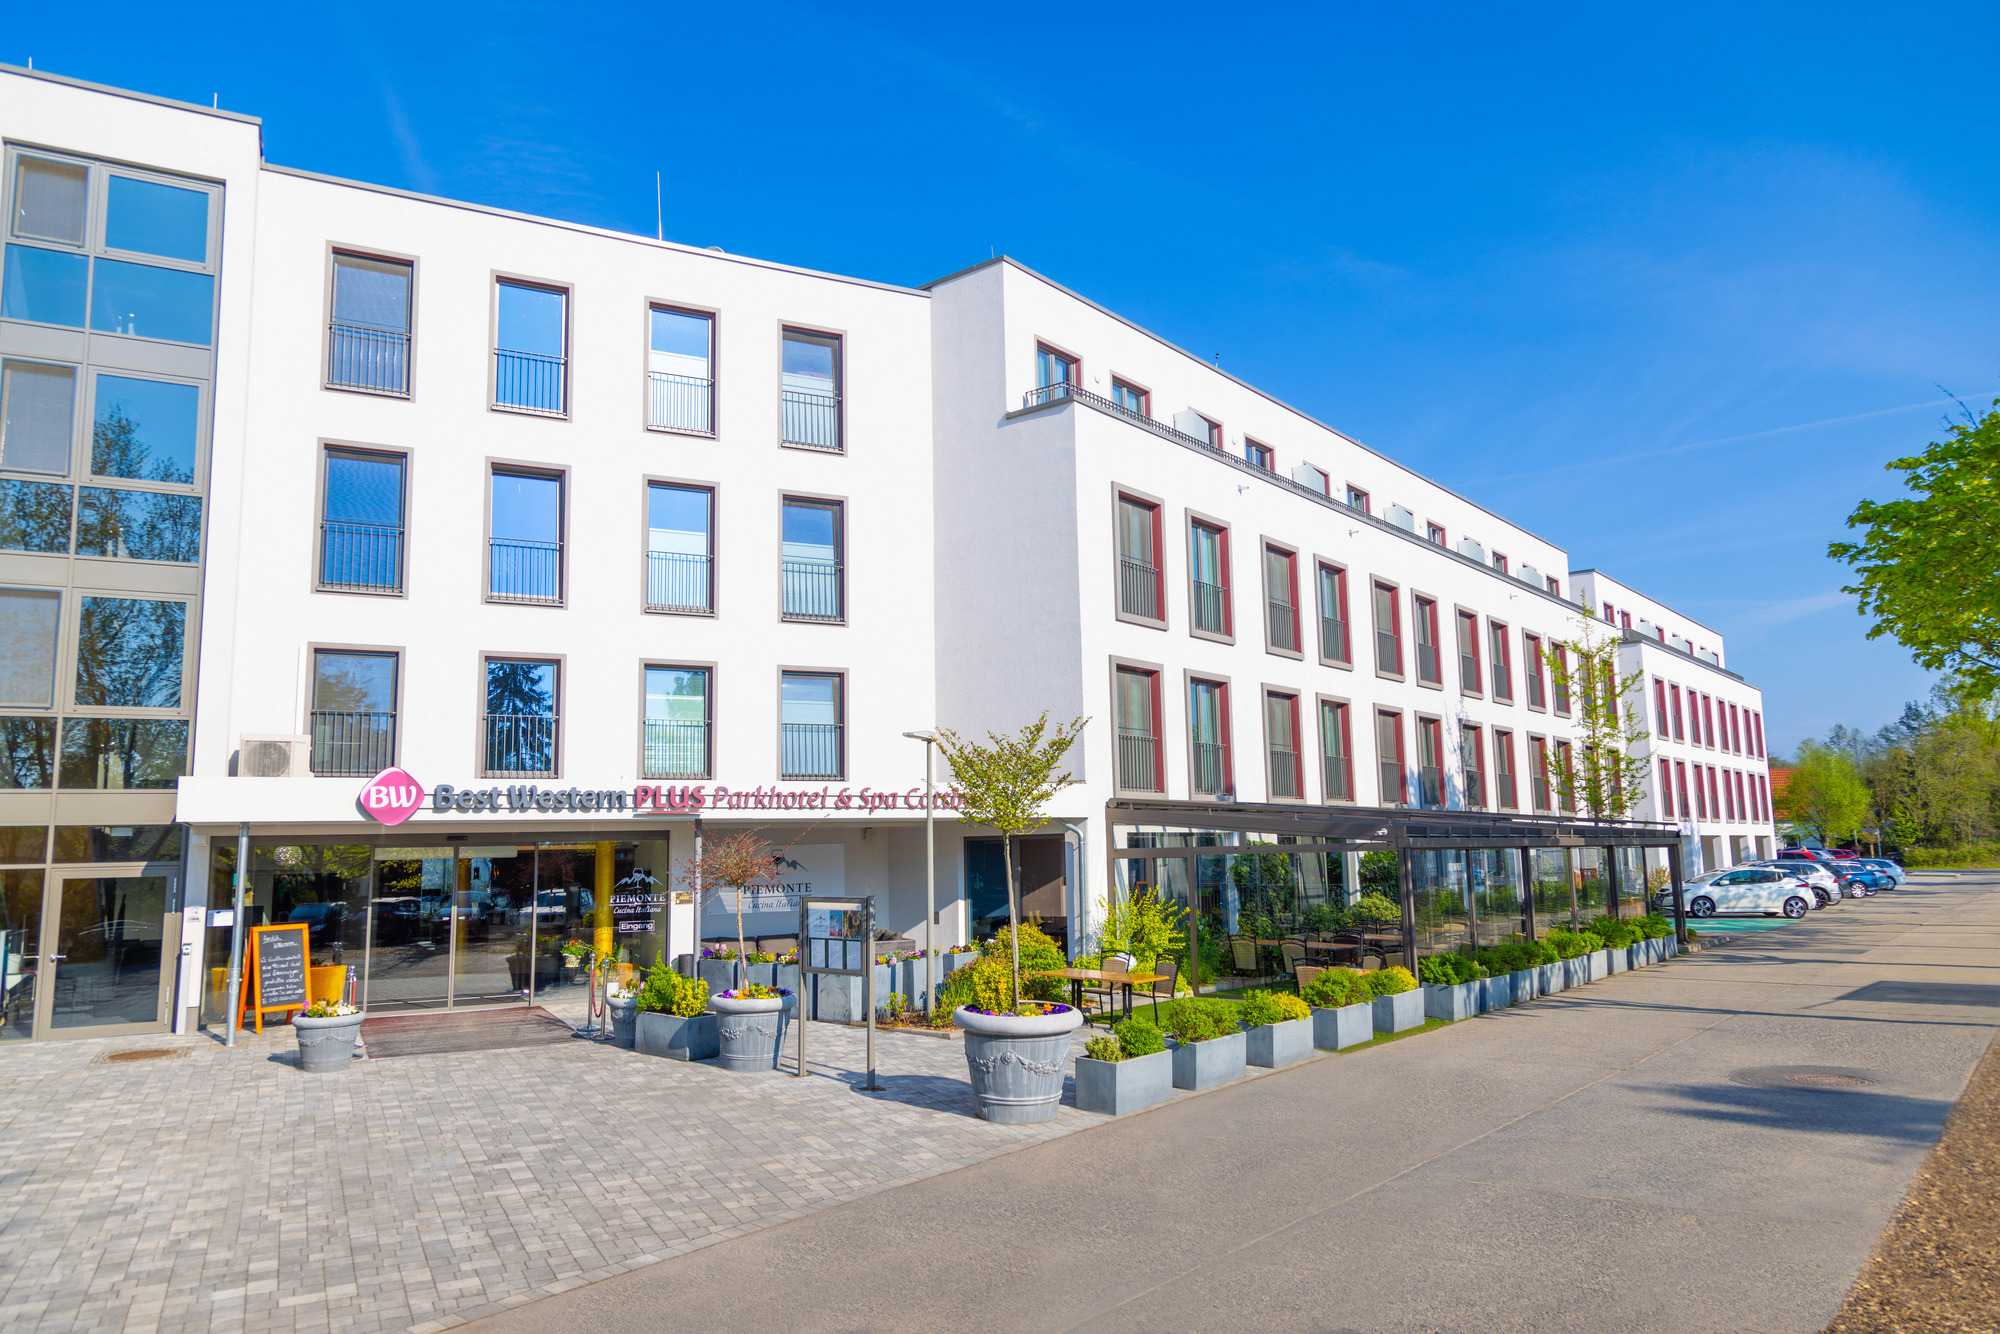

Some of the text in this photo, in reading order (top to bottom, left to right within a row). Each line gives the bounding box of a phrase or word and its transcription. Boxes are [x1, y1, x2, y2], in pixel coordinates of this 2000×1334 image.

[369, 785, 417, 809] BW
[433, 784, 503, 810] Best
[508, 784, 629, 810] Western
[635, 785, 706, 809] PLUS
[712, 785, 829, 809] Parkhotel
[834, 787, 853, 809] &
[858, 787, 899, 813] Spa
[743, 882, 812, 895] PIEMONTE
[609, 893, 666, 904] PIEMONTE
[748, 898, 800, 909] Cucina Italia
[613, 905, 662, 914] Cucina Italiana
[621, 923, 654, 931] Eingang
